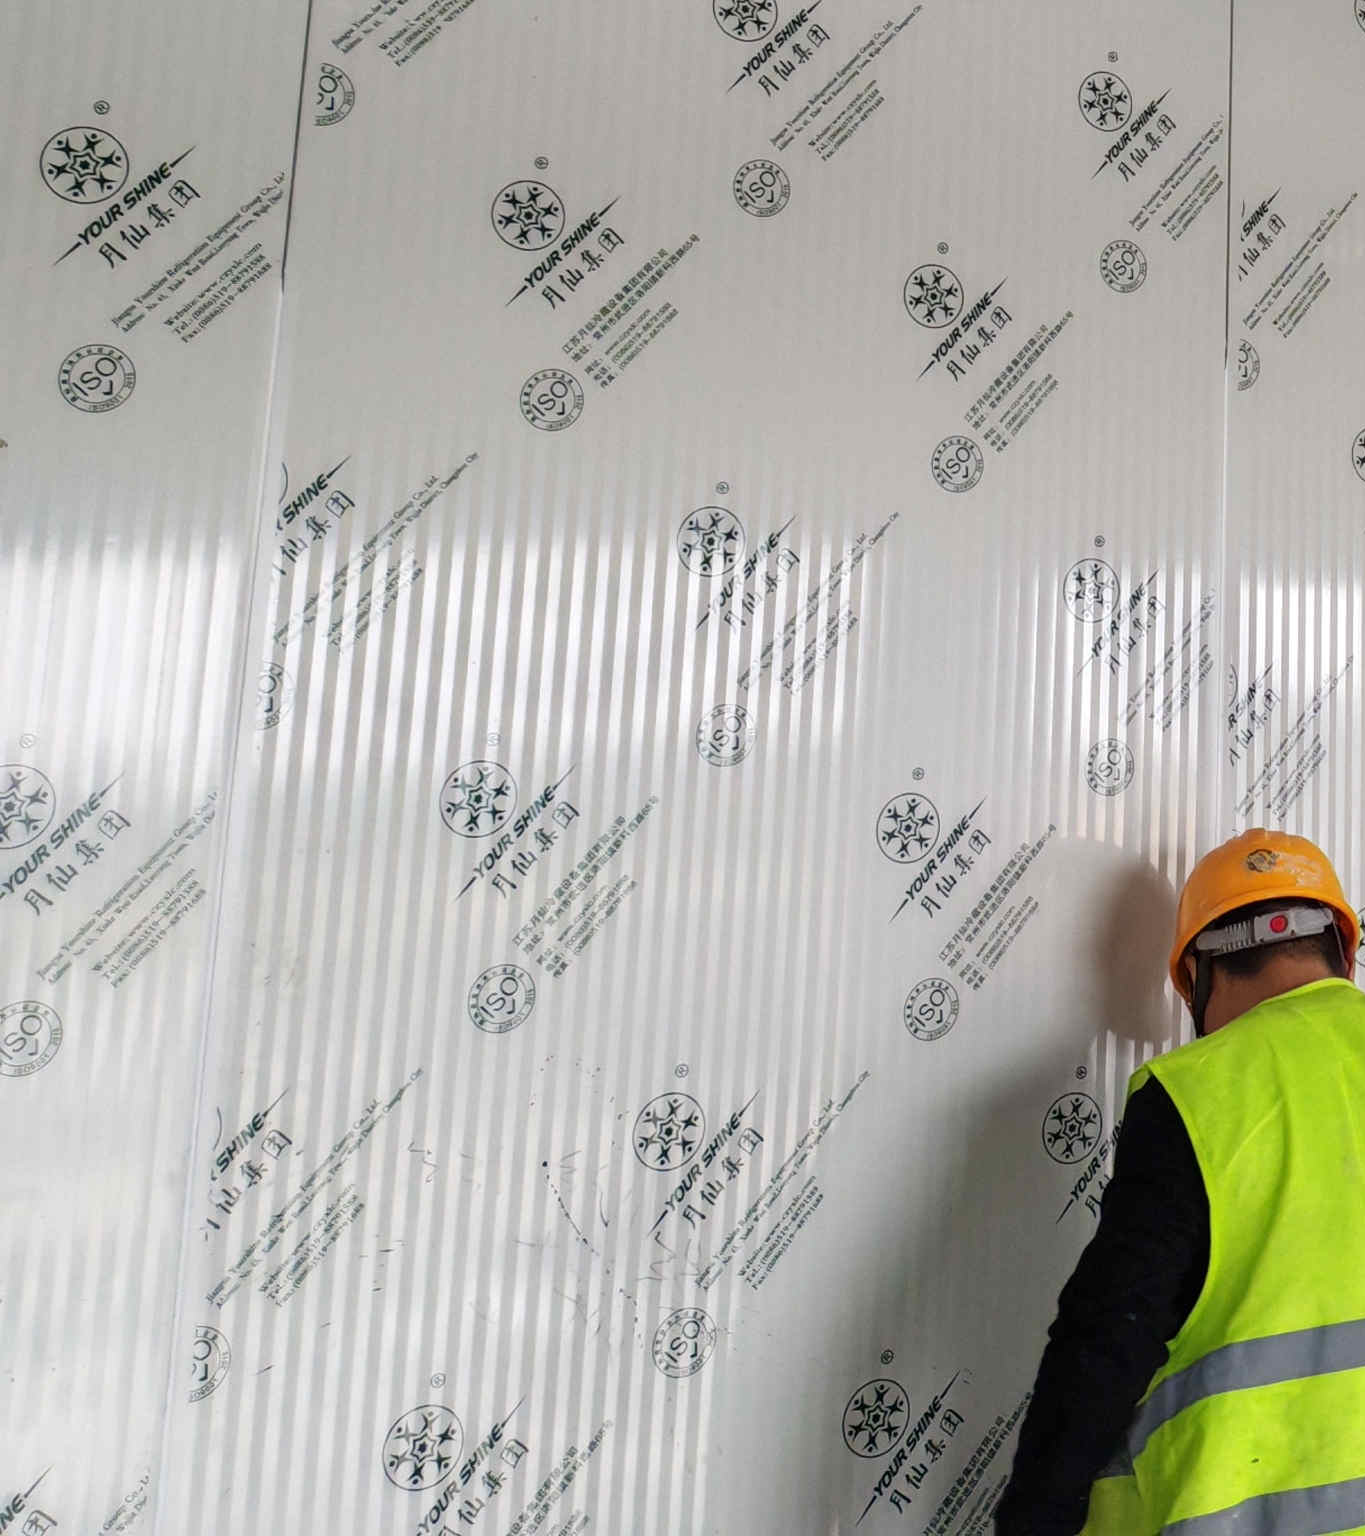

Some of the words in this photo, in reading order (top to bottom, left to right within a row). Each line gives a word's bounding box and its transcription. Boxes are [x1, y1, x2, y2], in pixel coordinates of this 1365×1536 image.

[742, 41, 775, 75] YOUR
[774, 9, 810, 47] SHINE
[1104, 131, 1131, 163] YOUR
[1130, 100, 1159, 136] SHINE
[77, 203, 123, 244] YOUR
[122, 162, 173, 209] SHINE
[741, 166, 779, 203] ISO
[524, 249, 562, 287] YOUR
[561, 211, 601, 255] SHINE
[1106, 247, 1137, 280] ISO
[931, 327, 961, 362] YOUR
[960, 292, 993, 332] SHINE
[68, 352, 121, 396] ISO
[528, 376, 571, 416] ISO
[938, 442, 973, 479] ISO
[905, 858, 937, 899] YOUR
[936, 816, 971, 863] SHINE
[911, 984, 948, 1027] ISO
[874, 1448, 907, 1495] YOUR
[906, 1396, 943, 1451] SHINE
